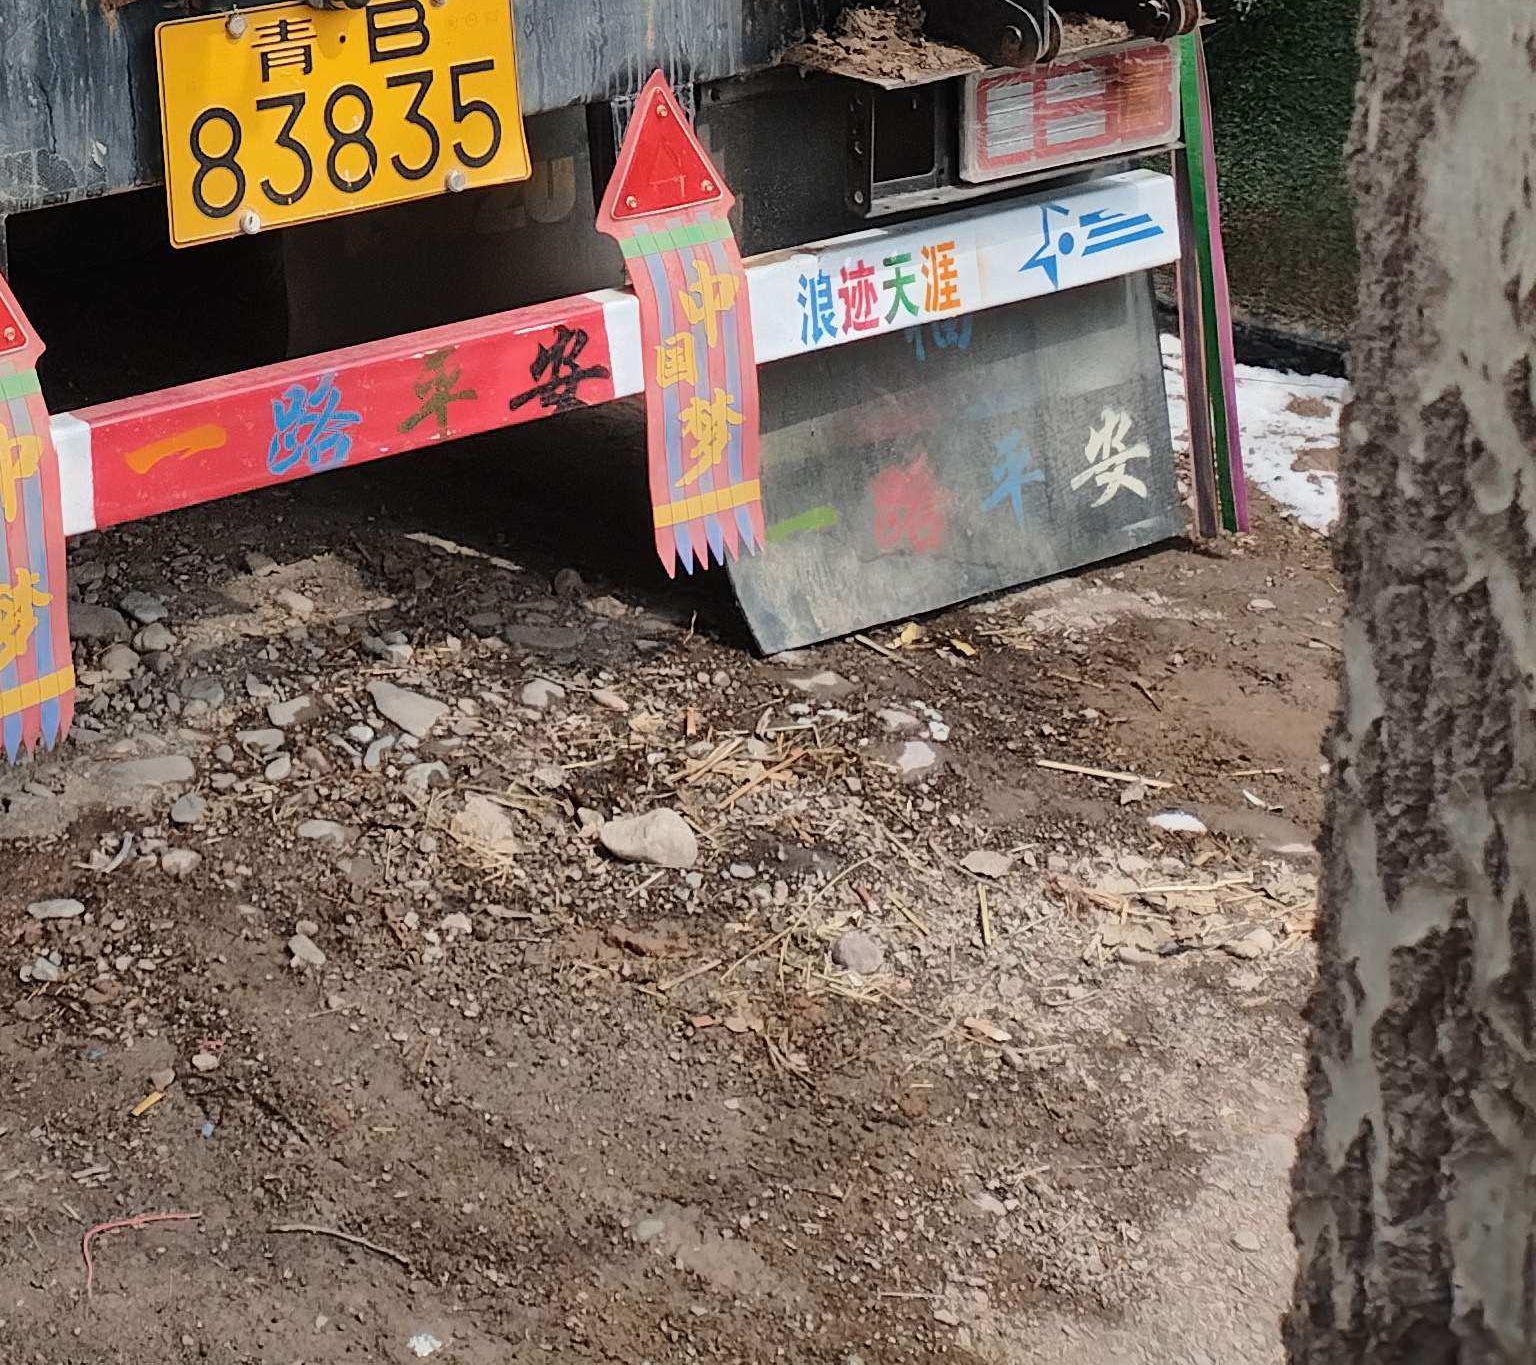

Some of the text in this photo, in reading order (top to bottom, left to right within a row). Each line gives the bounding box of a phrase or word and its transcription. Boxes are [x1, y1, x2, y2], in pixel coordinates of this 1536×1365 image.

[190, 59, 502, 219] 83835
[797, 239, 961, 346] 浪迹天涯
[124, 324, 610, 475] 一路平安
[654, 259, 744, 489] 中国梦
